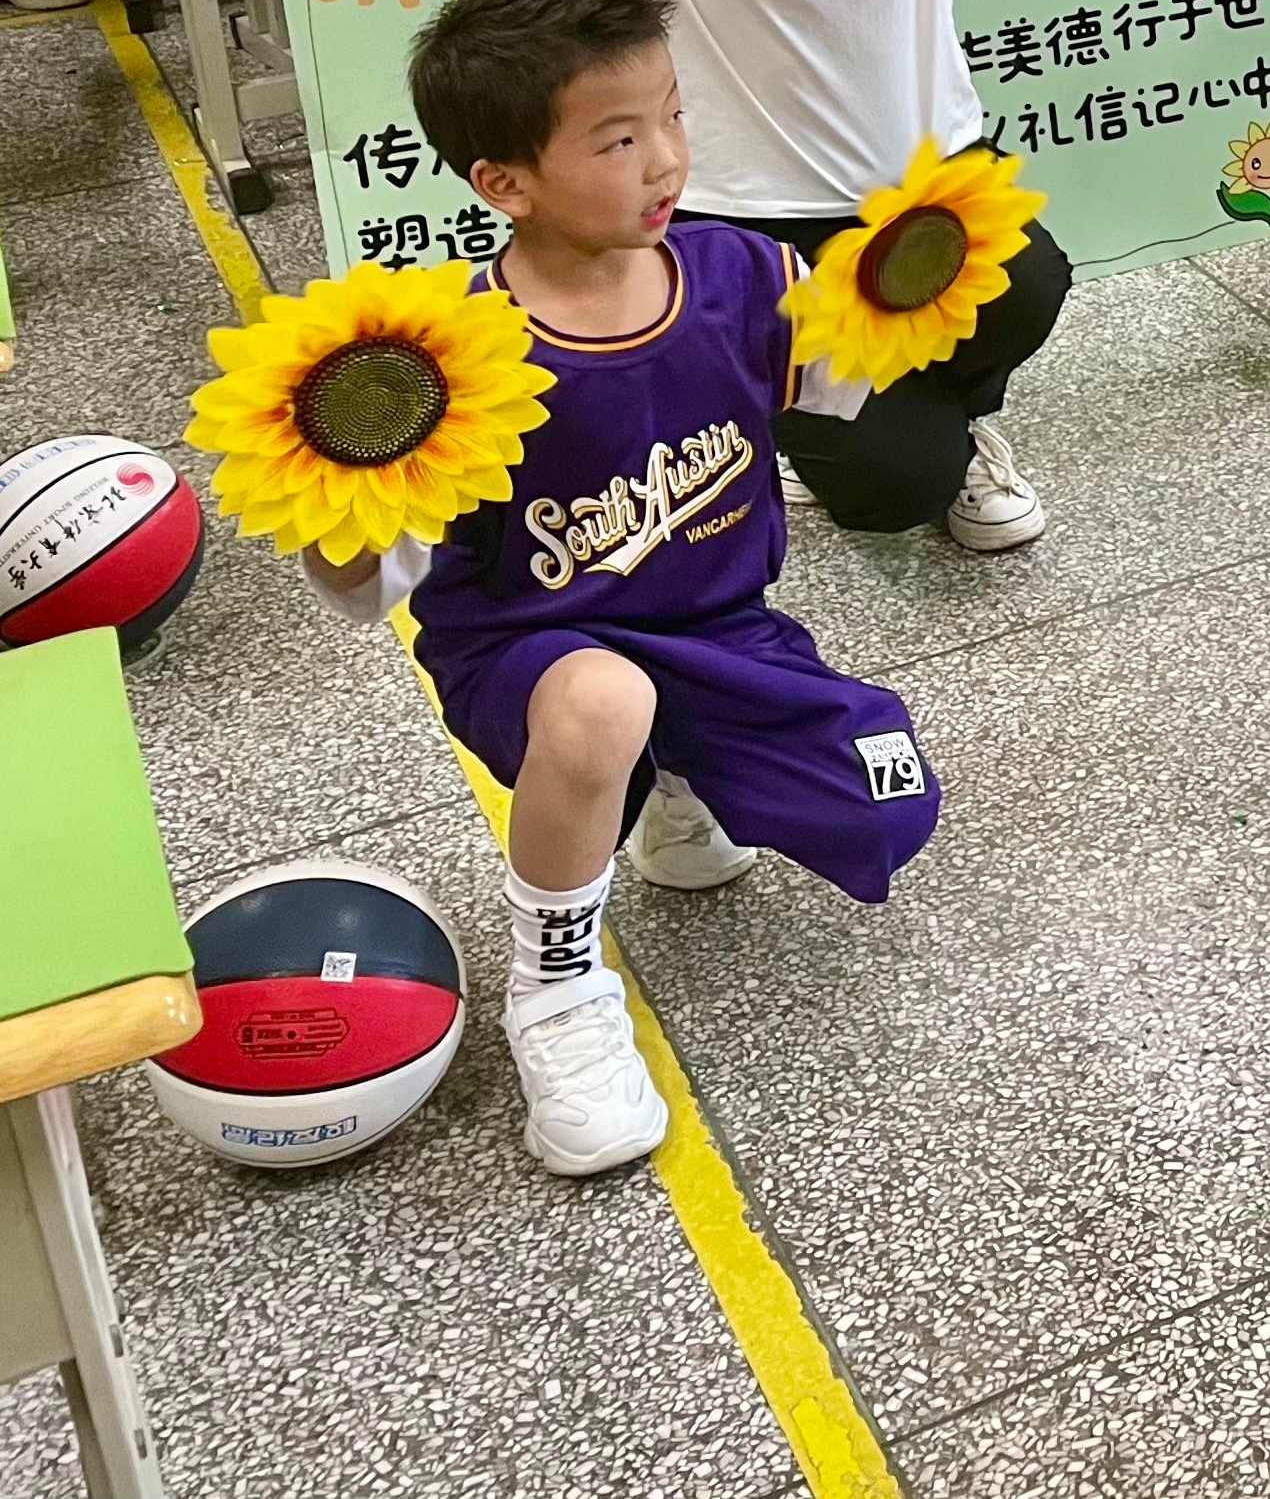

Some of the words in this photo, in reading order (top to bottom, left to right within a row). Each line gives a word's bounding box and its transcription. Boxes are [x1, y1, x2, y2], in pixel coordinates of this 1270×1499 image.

[343, 123, 444, 189] 传
[357, 203, 514, 275] 塑造
[7, 485, 128, 591] 北京体育大学
[524, 474, 642, 591] South
[628, 419, 753, 546] Austin
[864, 738, 905, 754] SNOW
[872, 758, 920, 794] 79
